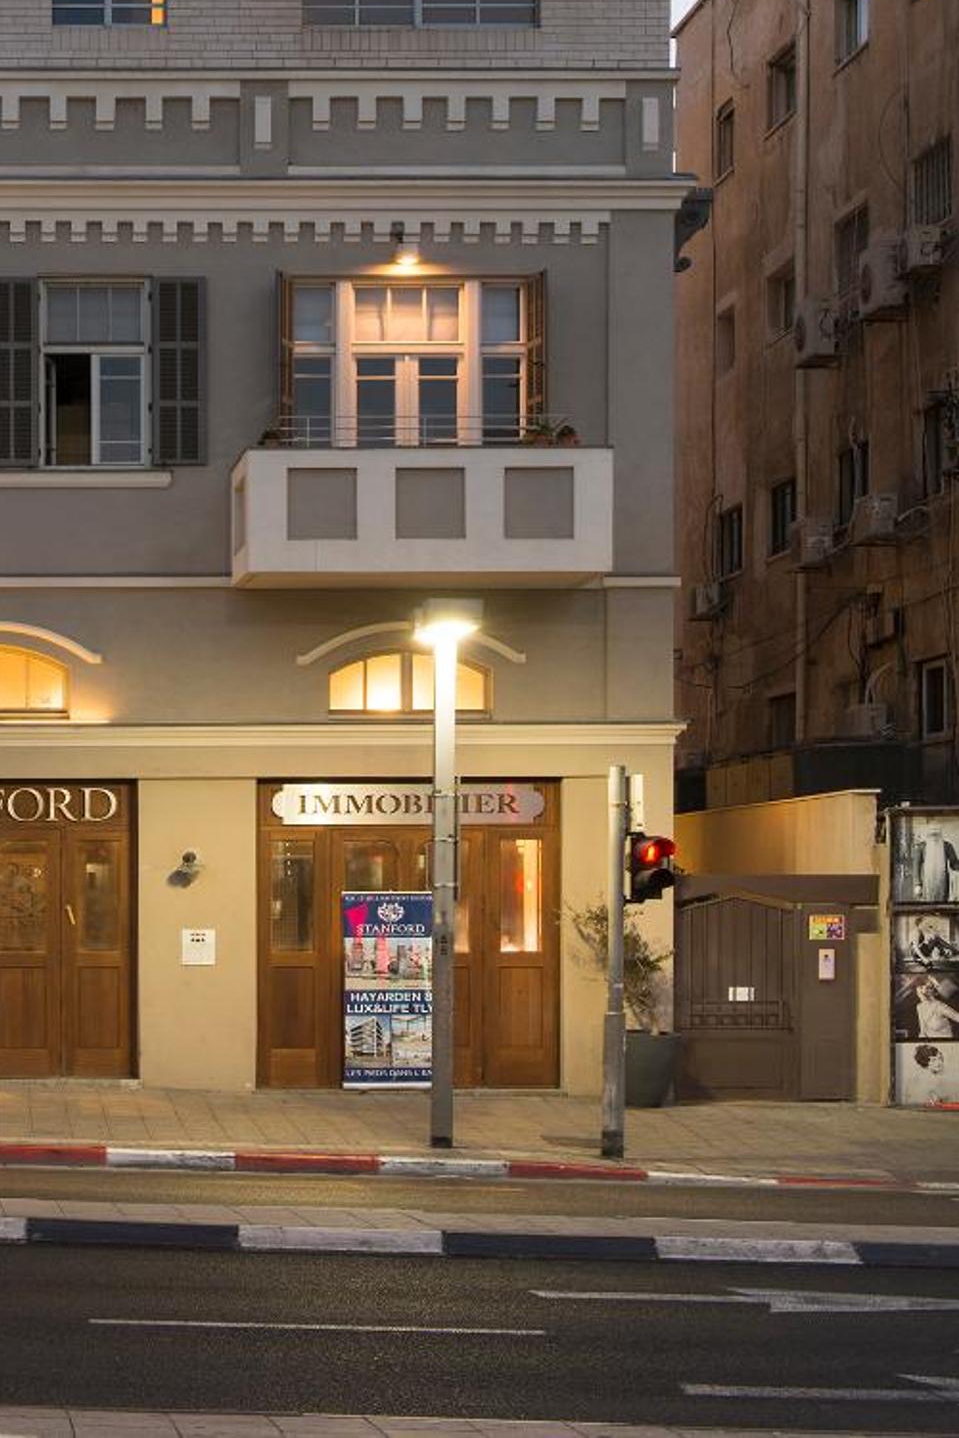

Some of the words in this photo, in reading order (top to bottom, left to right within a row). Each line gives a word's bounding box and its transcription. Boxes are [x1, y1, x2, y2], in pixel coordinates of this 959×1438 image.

[298, 792, 520, 815] IMMOBIIER
[355, 923, 426, 933] STANFORD
[350, 992, 421, 1002] HAYARDEN
